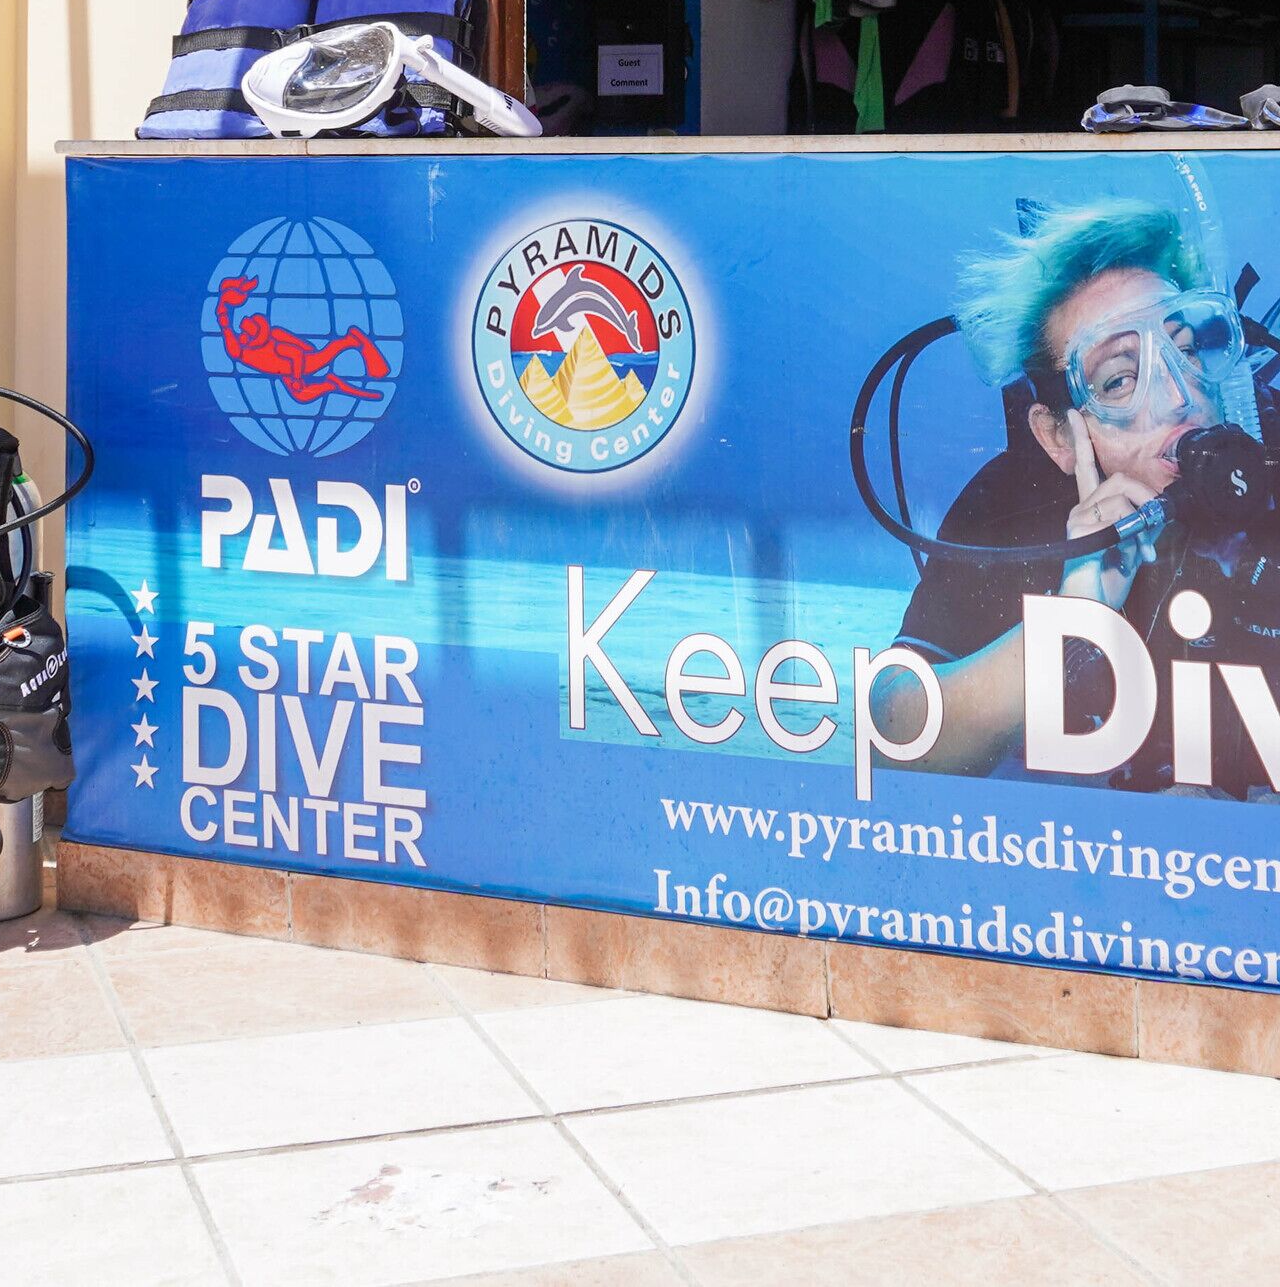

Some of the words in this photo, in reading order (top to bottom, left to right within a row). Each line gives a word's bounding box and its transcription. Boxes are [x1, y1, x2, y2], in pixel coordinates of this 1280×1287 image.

[610, 78, 648, 87] Comment
[618, 58, 641, 67] Guest
[486, 225, 681, 340] PYRAMIDS
[486, 360, 573, 463] Diving
[590, 362, 681, 461] Center
[1250, 556, 1268, 586] escape
[20, 669, 49, 698] AQUA
[183, 622, 216, 686] 5
[238, 623, 423, 704] STAR
[566, 565, 943, 801] Keep
[182, 685, 427, 808] DIVE
[180, 785, 427, 867] CENTER
